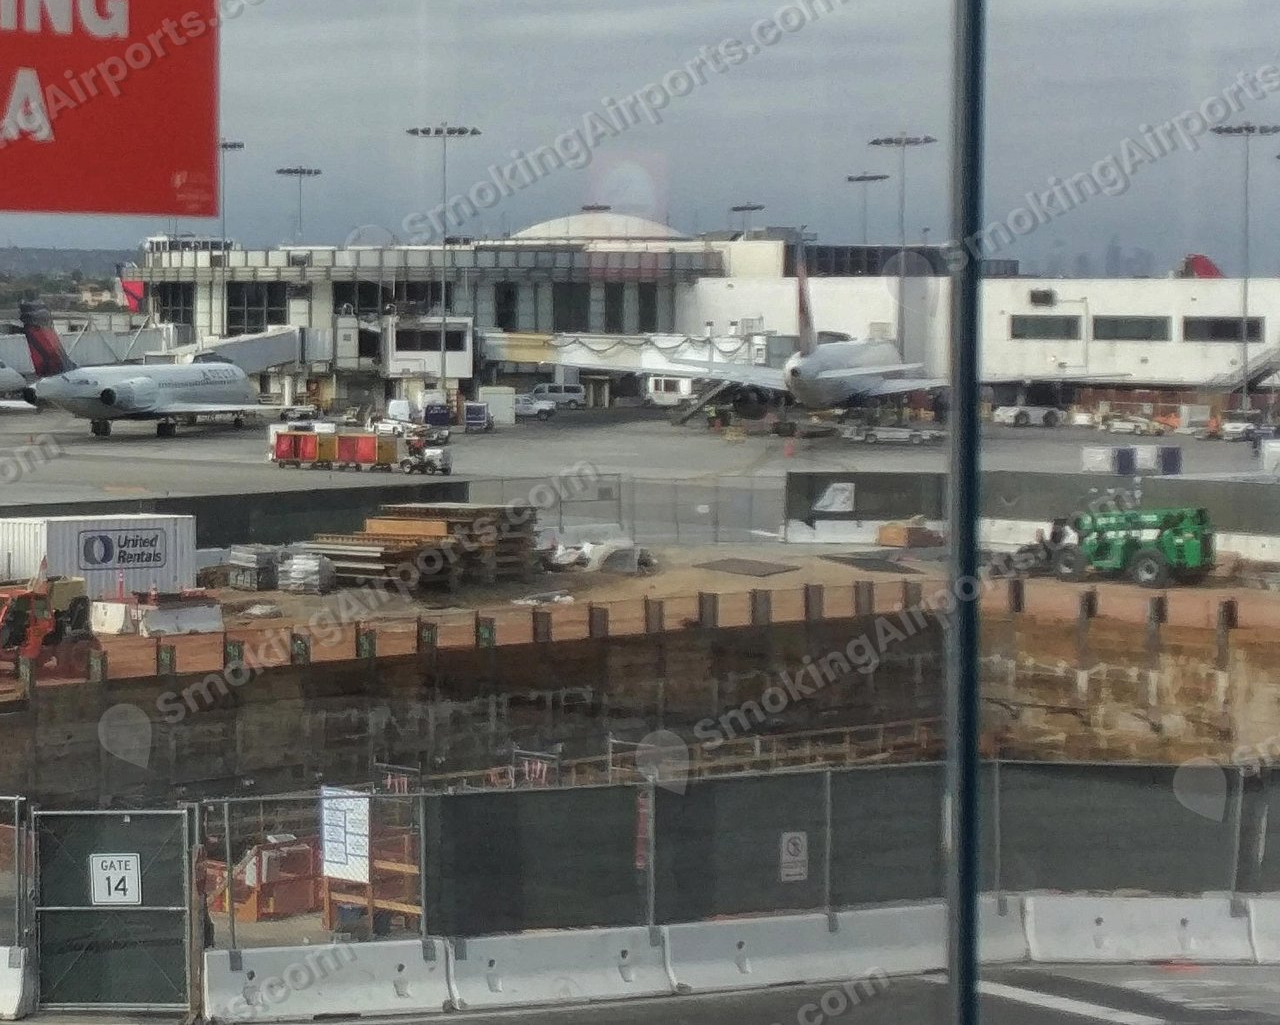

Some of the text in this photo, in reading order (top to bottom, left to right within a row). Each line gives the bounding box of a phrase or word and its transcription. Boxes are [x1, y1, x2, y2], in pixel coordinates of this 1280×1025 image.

[117, 534, 159, 549] United
[117, 549, 162, 564] Rentals
[100, 860, 131, 871] GATE
[105, 875, 128, 897] 14
